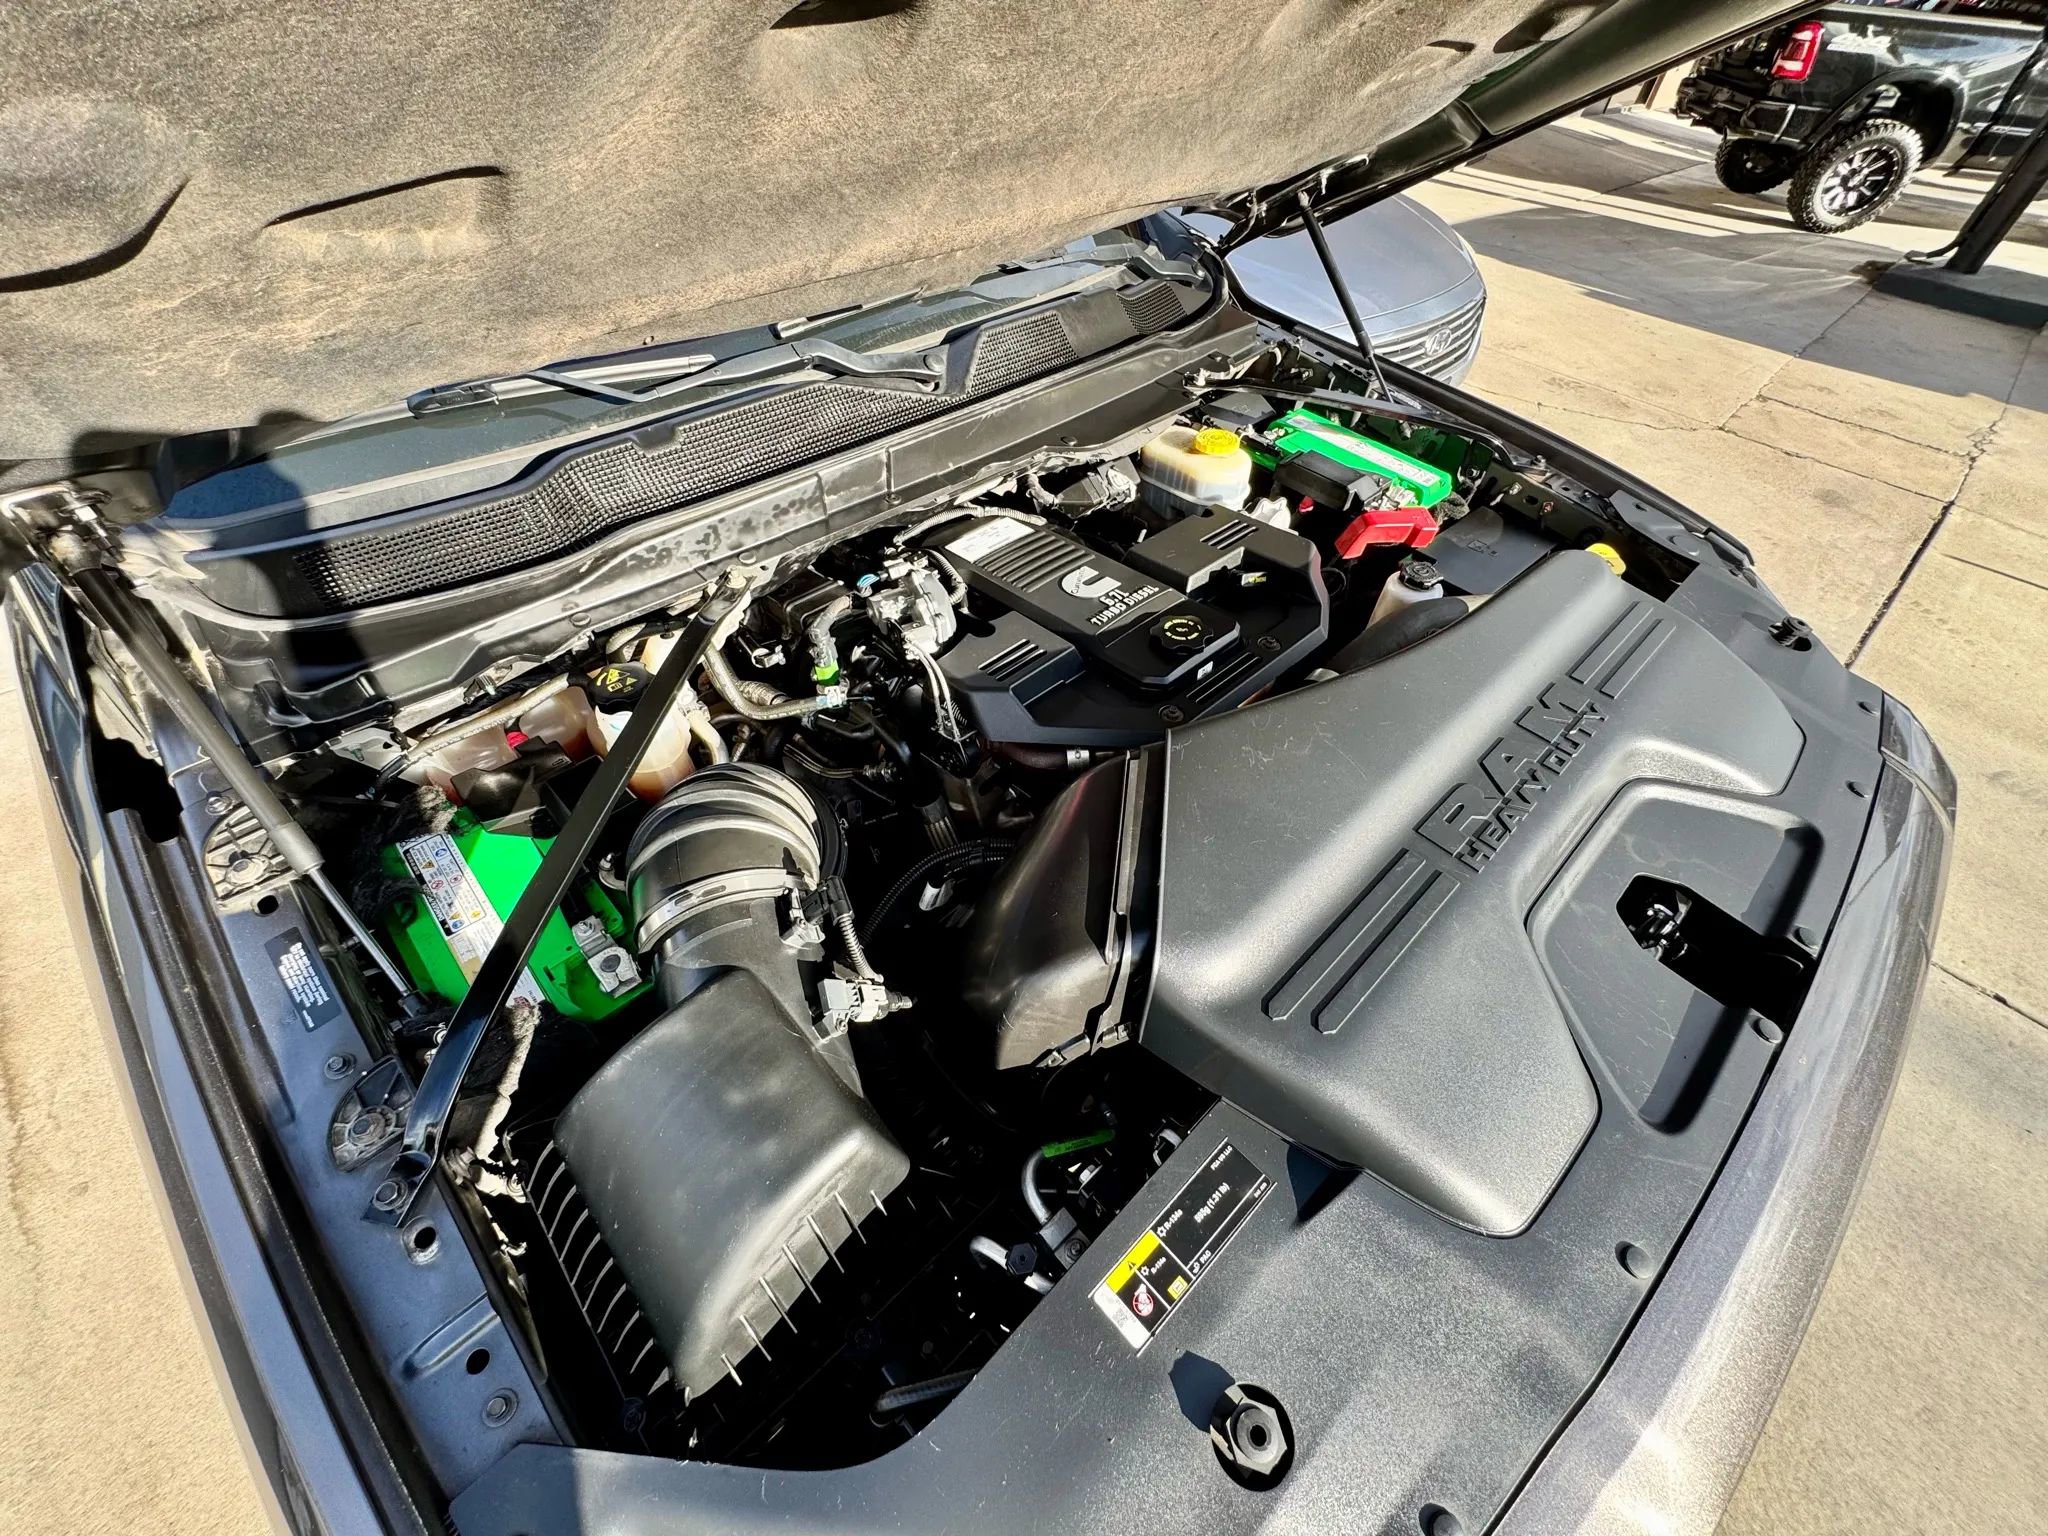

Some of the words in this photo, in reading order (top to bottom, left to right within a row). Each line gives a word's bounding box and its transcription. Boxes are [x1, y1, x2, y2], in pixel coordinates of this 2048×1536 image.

[1090, 603, 1127, 626] TURBO
[1123, 584, 1159, 606] DIESEL
[1100, 589, 1129, 606] 6.7L
[1412, 682, 1590, 857] RAM
[1454, 765, 1551, 873] HEAVY
[1537, 699, 1608, 776] DUTY
[1199, 1249, 1212, 1264] PAG
